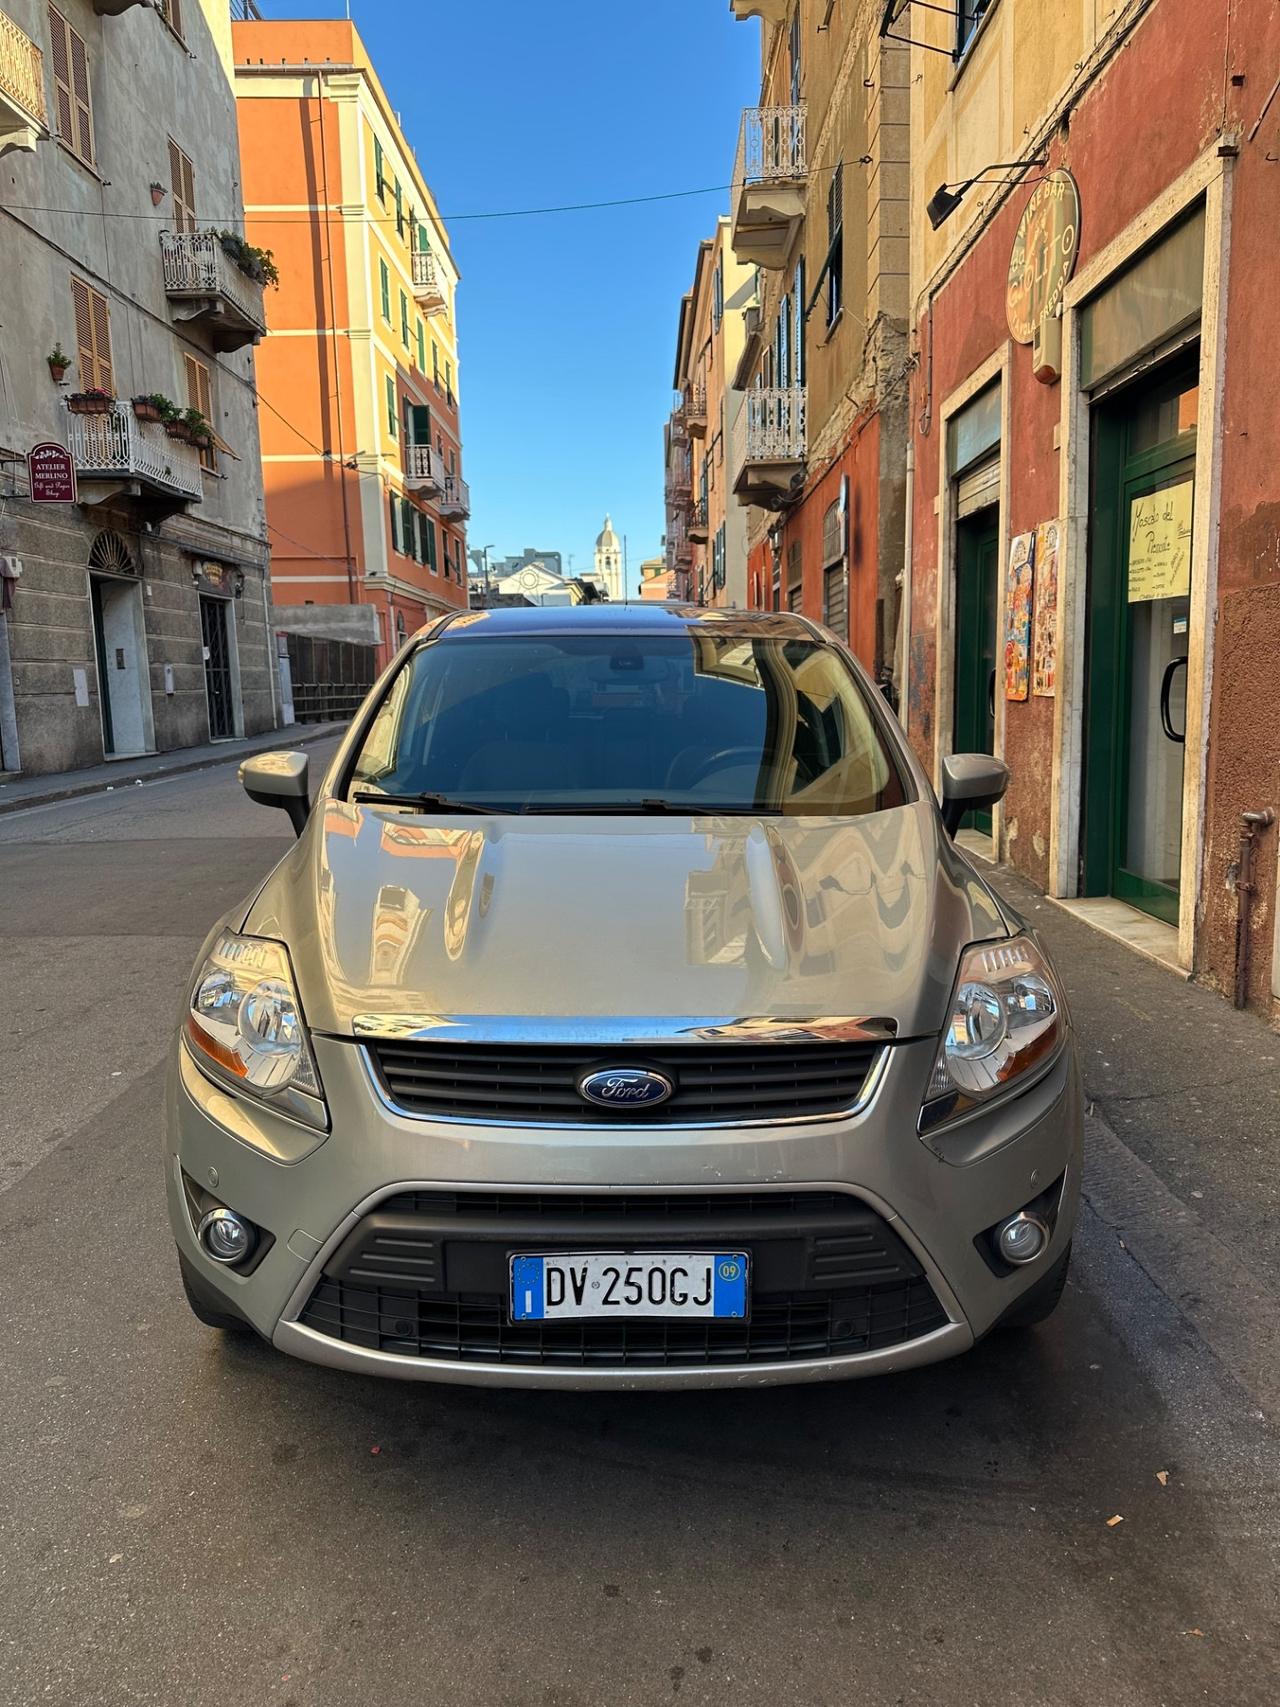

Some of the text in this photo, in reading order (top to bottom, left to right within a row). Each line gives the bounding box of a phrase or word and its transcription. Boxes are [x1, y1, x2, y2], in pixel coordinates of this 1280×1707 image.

[1017, 181, 1065, 239] WINE BAR
[1040, 260, 1070, 321] FREDDA
[35, 472, 68, 480] MERLINO
[1162, 501, 1174, 521] del
[601, 1077, 650, 1099] Ford
[546, 1267, 588, 1307] DV
[601, 1267, 712, 1307] 250GJ
[721, 1264, 736, 1278] 09
